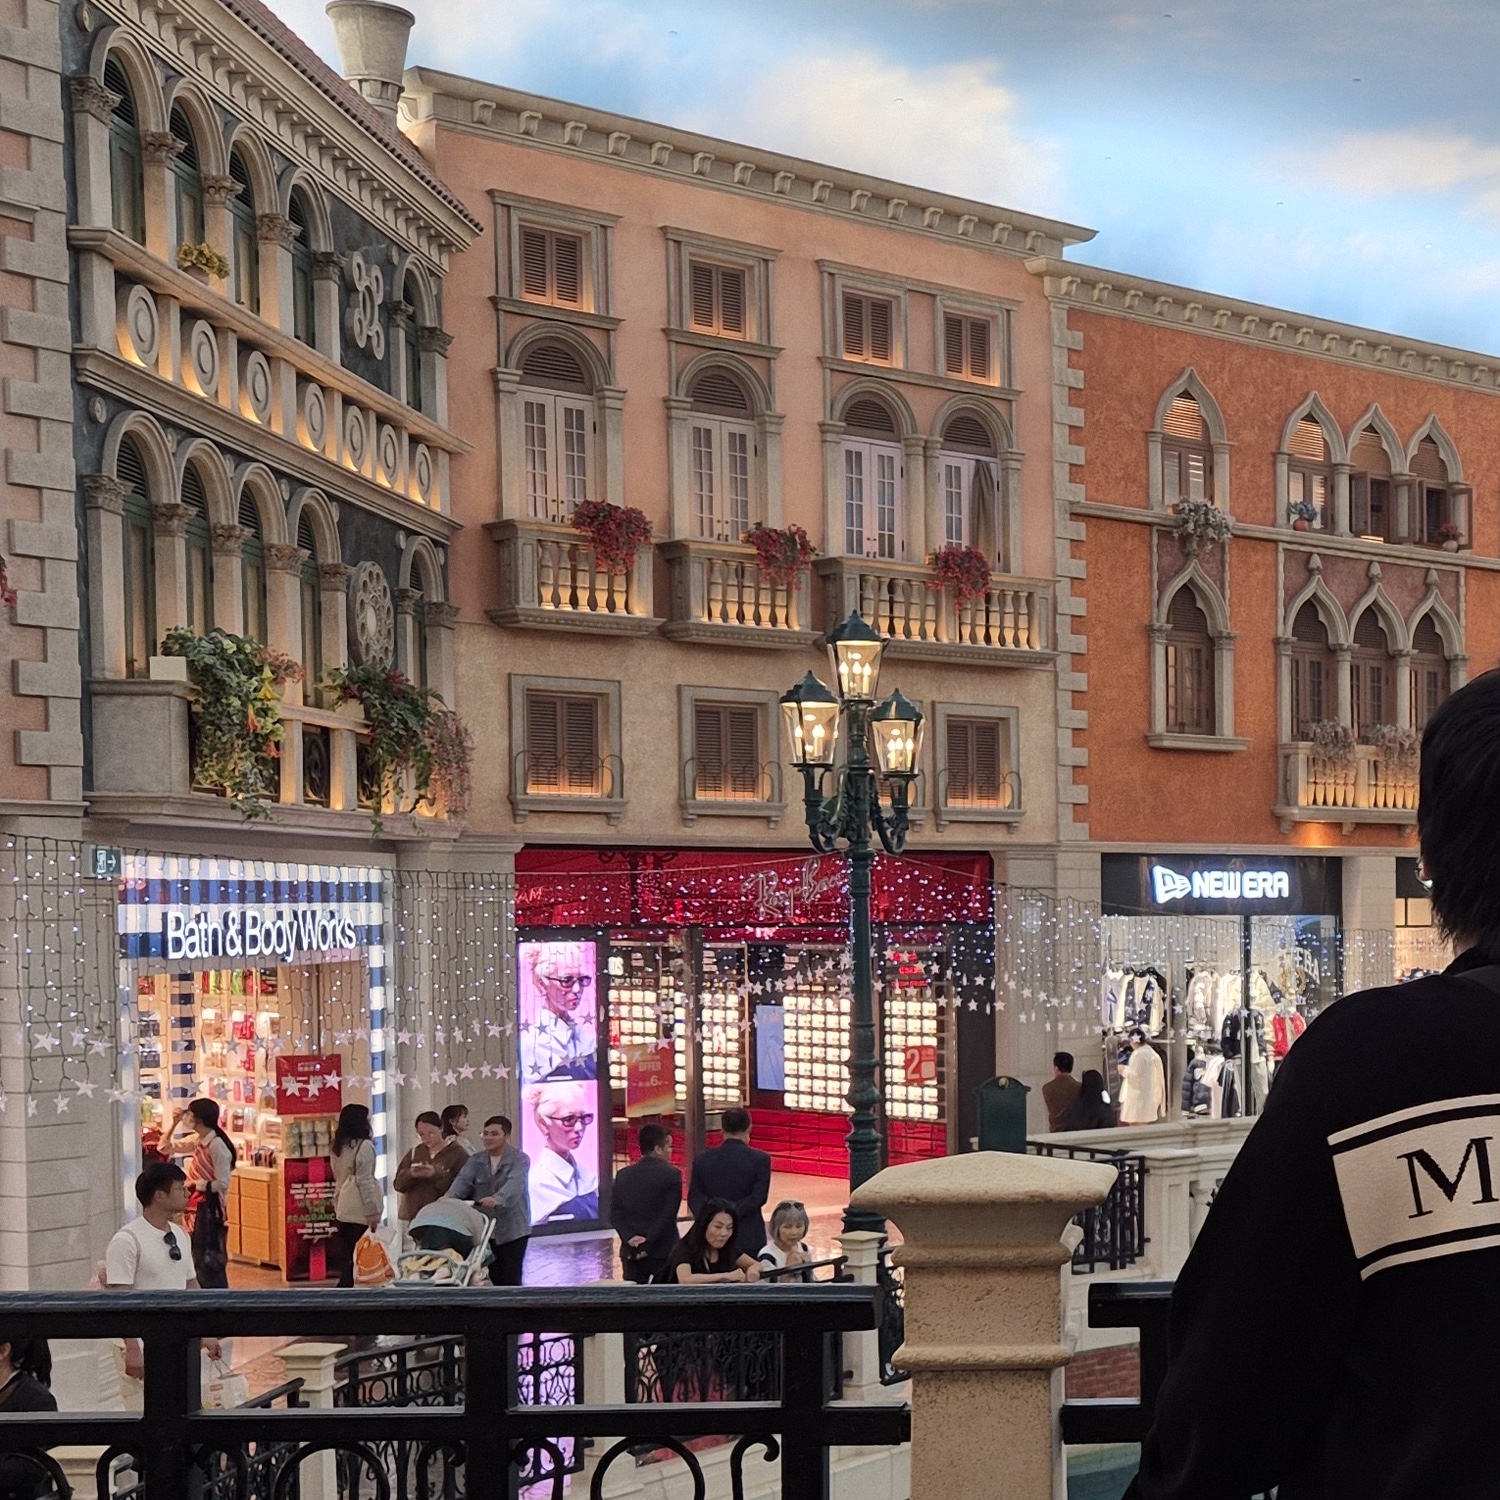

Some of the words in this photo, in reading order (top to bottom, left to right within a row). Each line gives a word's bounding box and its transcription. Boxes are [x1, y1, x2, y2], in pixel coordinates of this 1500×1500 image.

[1192, 871, 1241, 898] NEW
[1242, 871, 1289, 898] ERA
[167, 911, 222, 959] Bath
[226, 911, 243, 956] &
[245, 910, 297, 962] Body
[298, 909, 356, 951] Works
